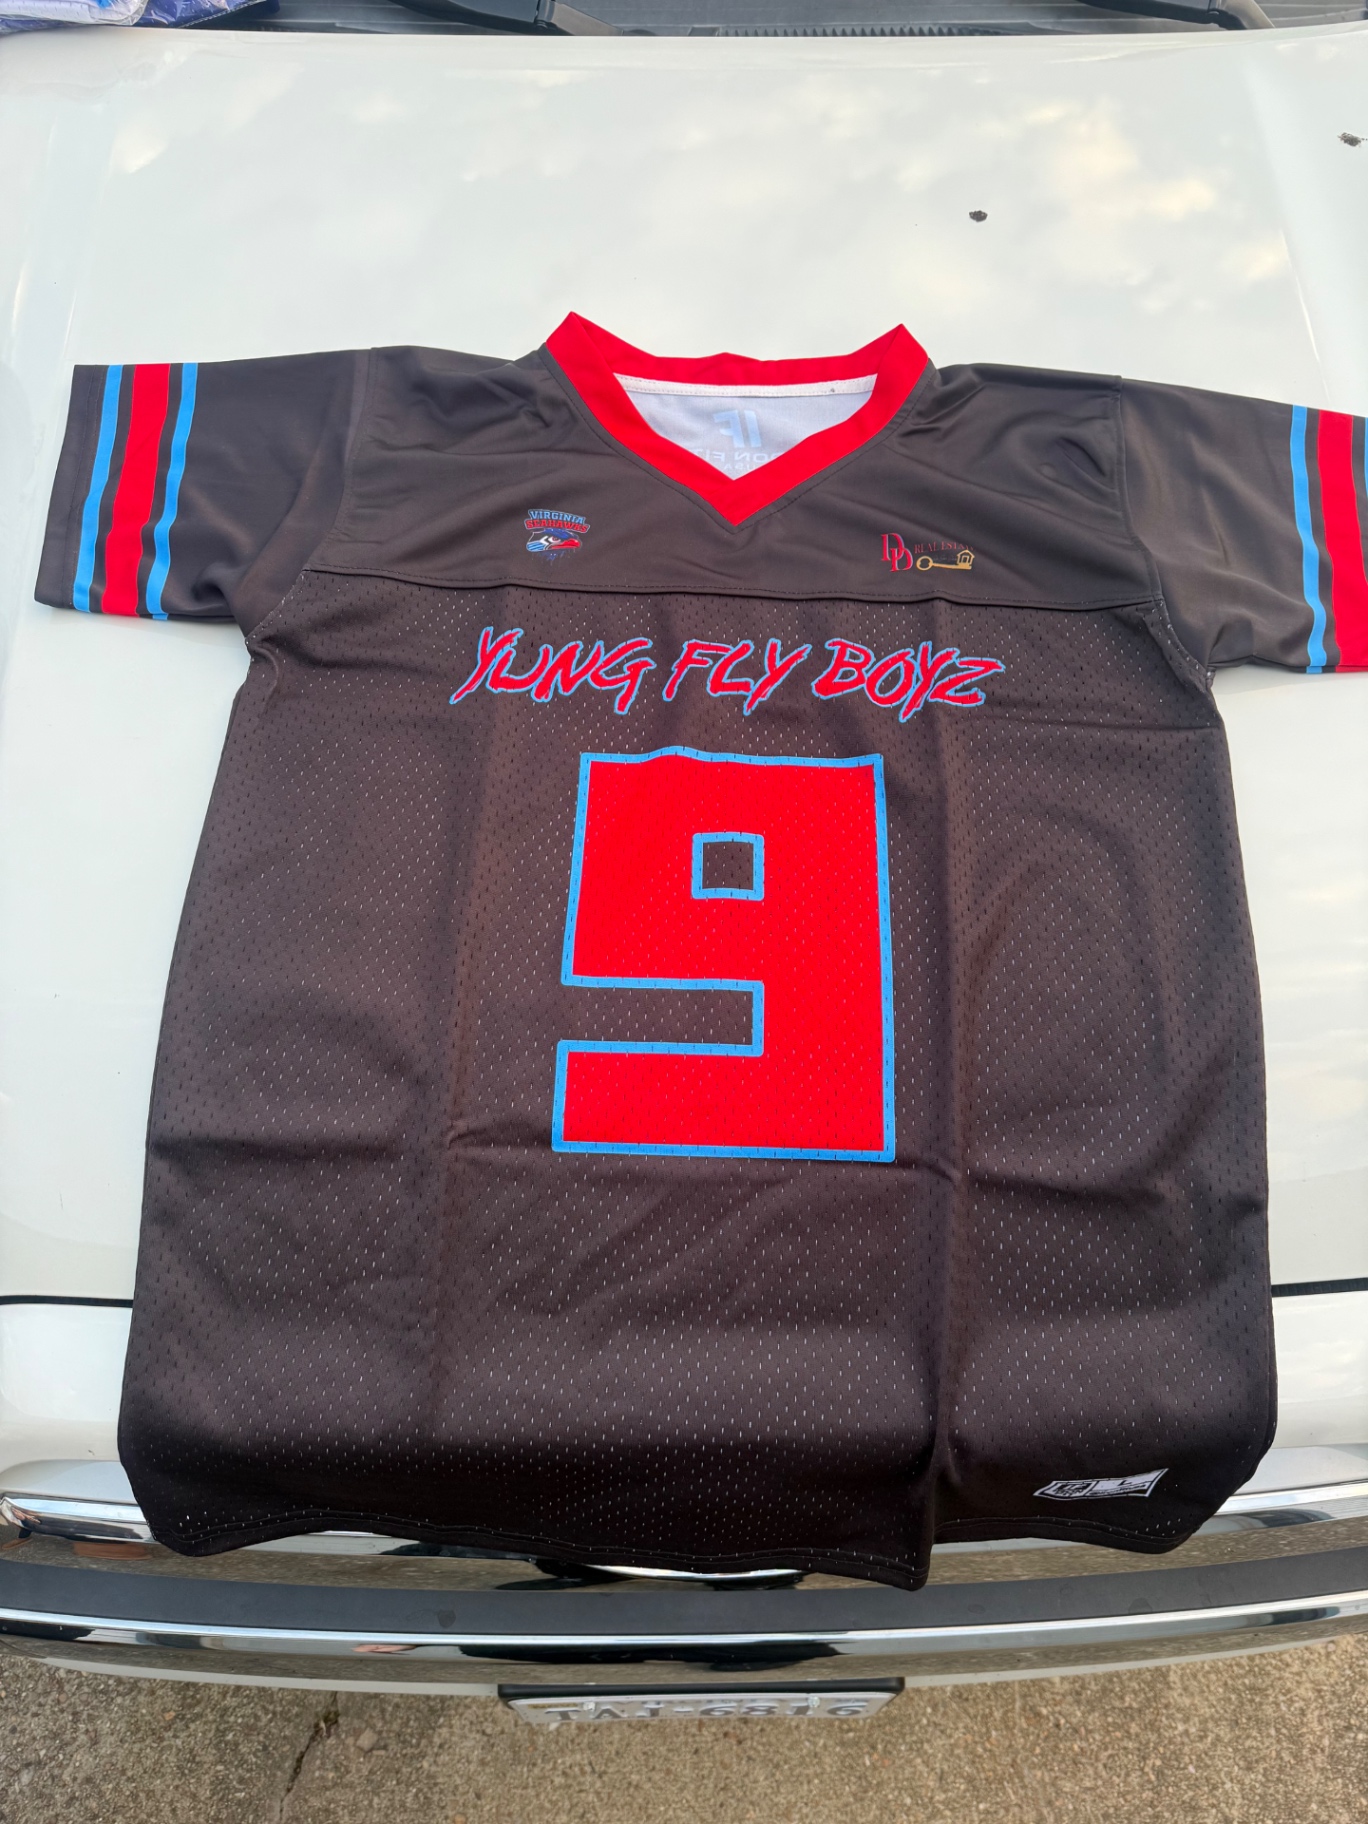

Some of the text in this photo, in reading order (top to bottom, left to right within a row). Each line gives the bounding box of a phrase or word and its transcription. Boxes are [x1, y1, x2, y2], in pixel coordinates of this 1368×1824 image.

[525, 519, 589, 533] SEAHAWKS
[529, 510, 585, 524] VIRGINIA
[450, 627, 1005, 722] YUNG FLY BOYZ
[552, 746, 896, 1162] 9
